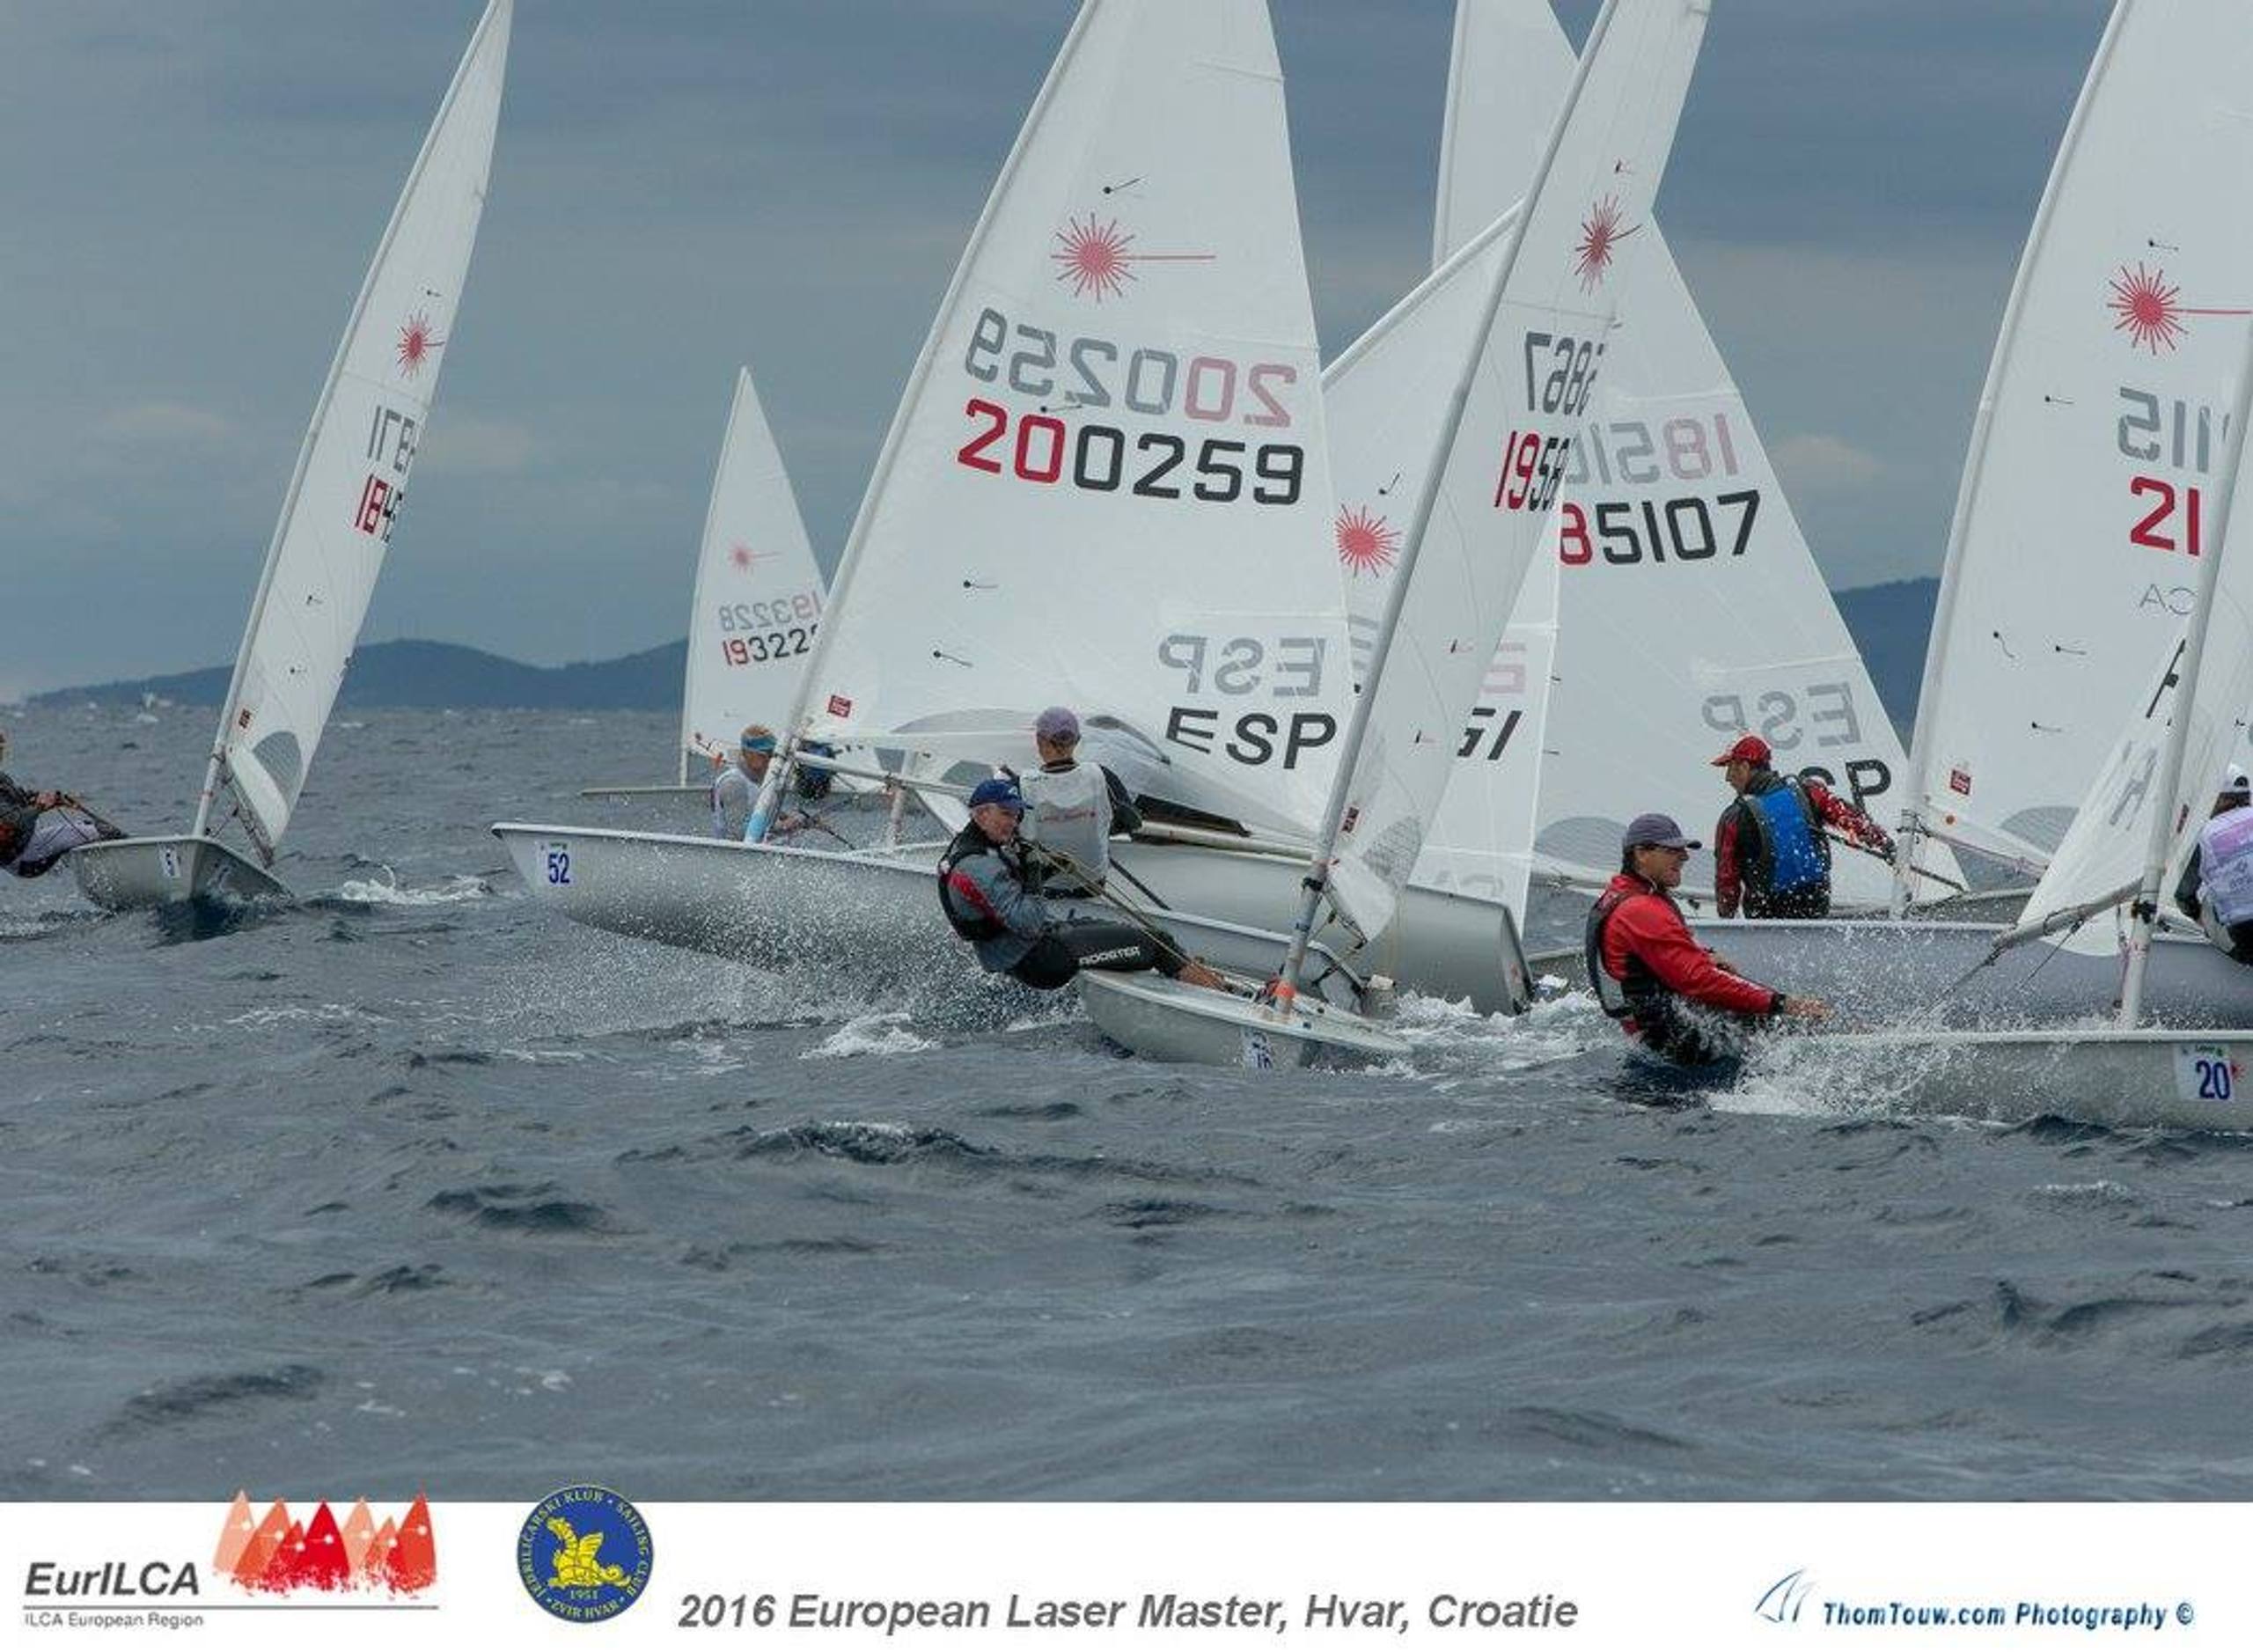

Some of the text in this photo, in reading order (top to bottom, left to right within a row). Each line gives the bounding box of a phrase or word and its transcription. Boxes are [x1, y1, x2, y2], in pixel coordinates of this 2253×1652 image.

[957, 399, 1304, 506] 200259
[723, 623, 818, 666] 19322
[1165, 707, 1338, 769] ESP
[548, 853, 570, 885] 52
[2195, 1060, 2231, 1100] 20
